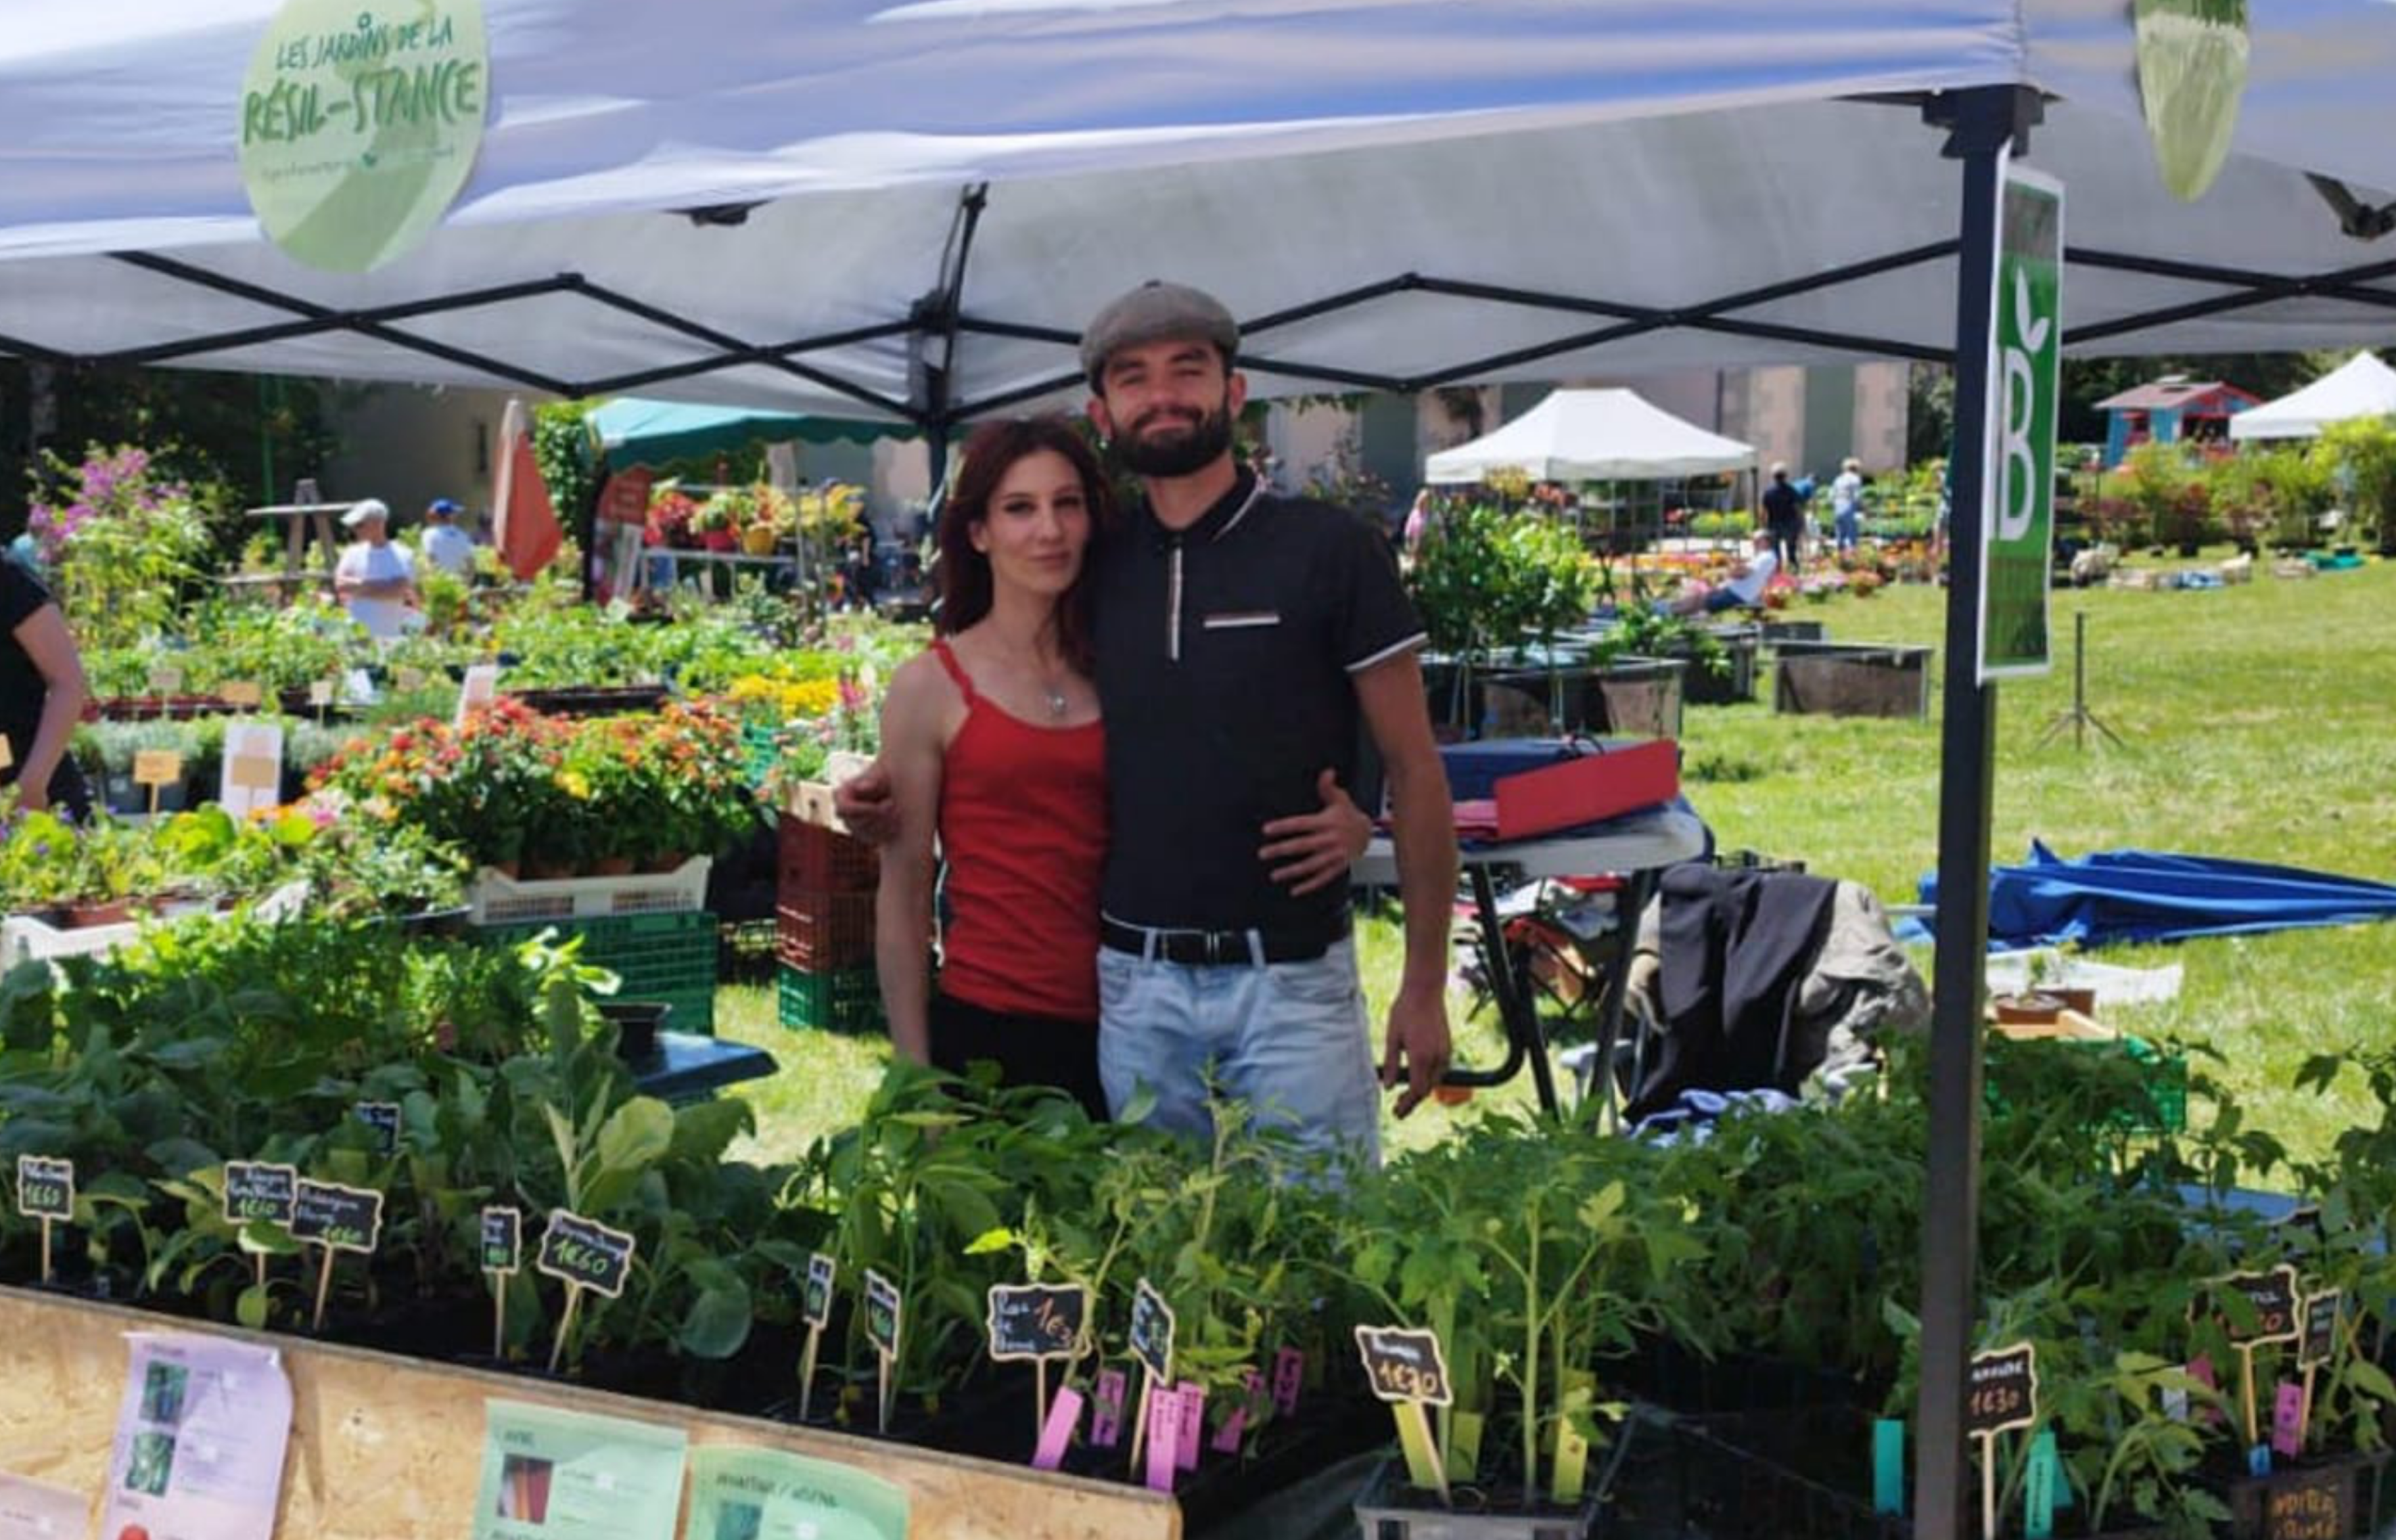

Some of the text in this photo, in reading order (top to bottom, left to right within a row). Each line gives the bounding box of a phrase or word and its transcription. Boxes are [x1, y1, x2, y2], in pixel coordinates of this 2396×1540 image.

[275, 12, 453, 71] LES JARDINS DE LA
